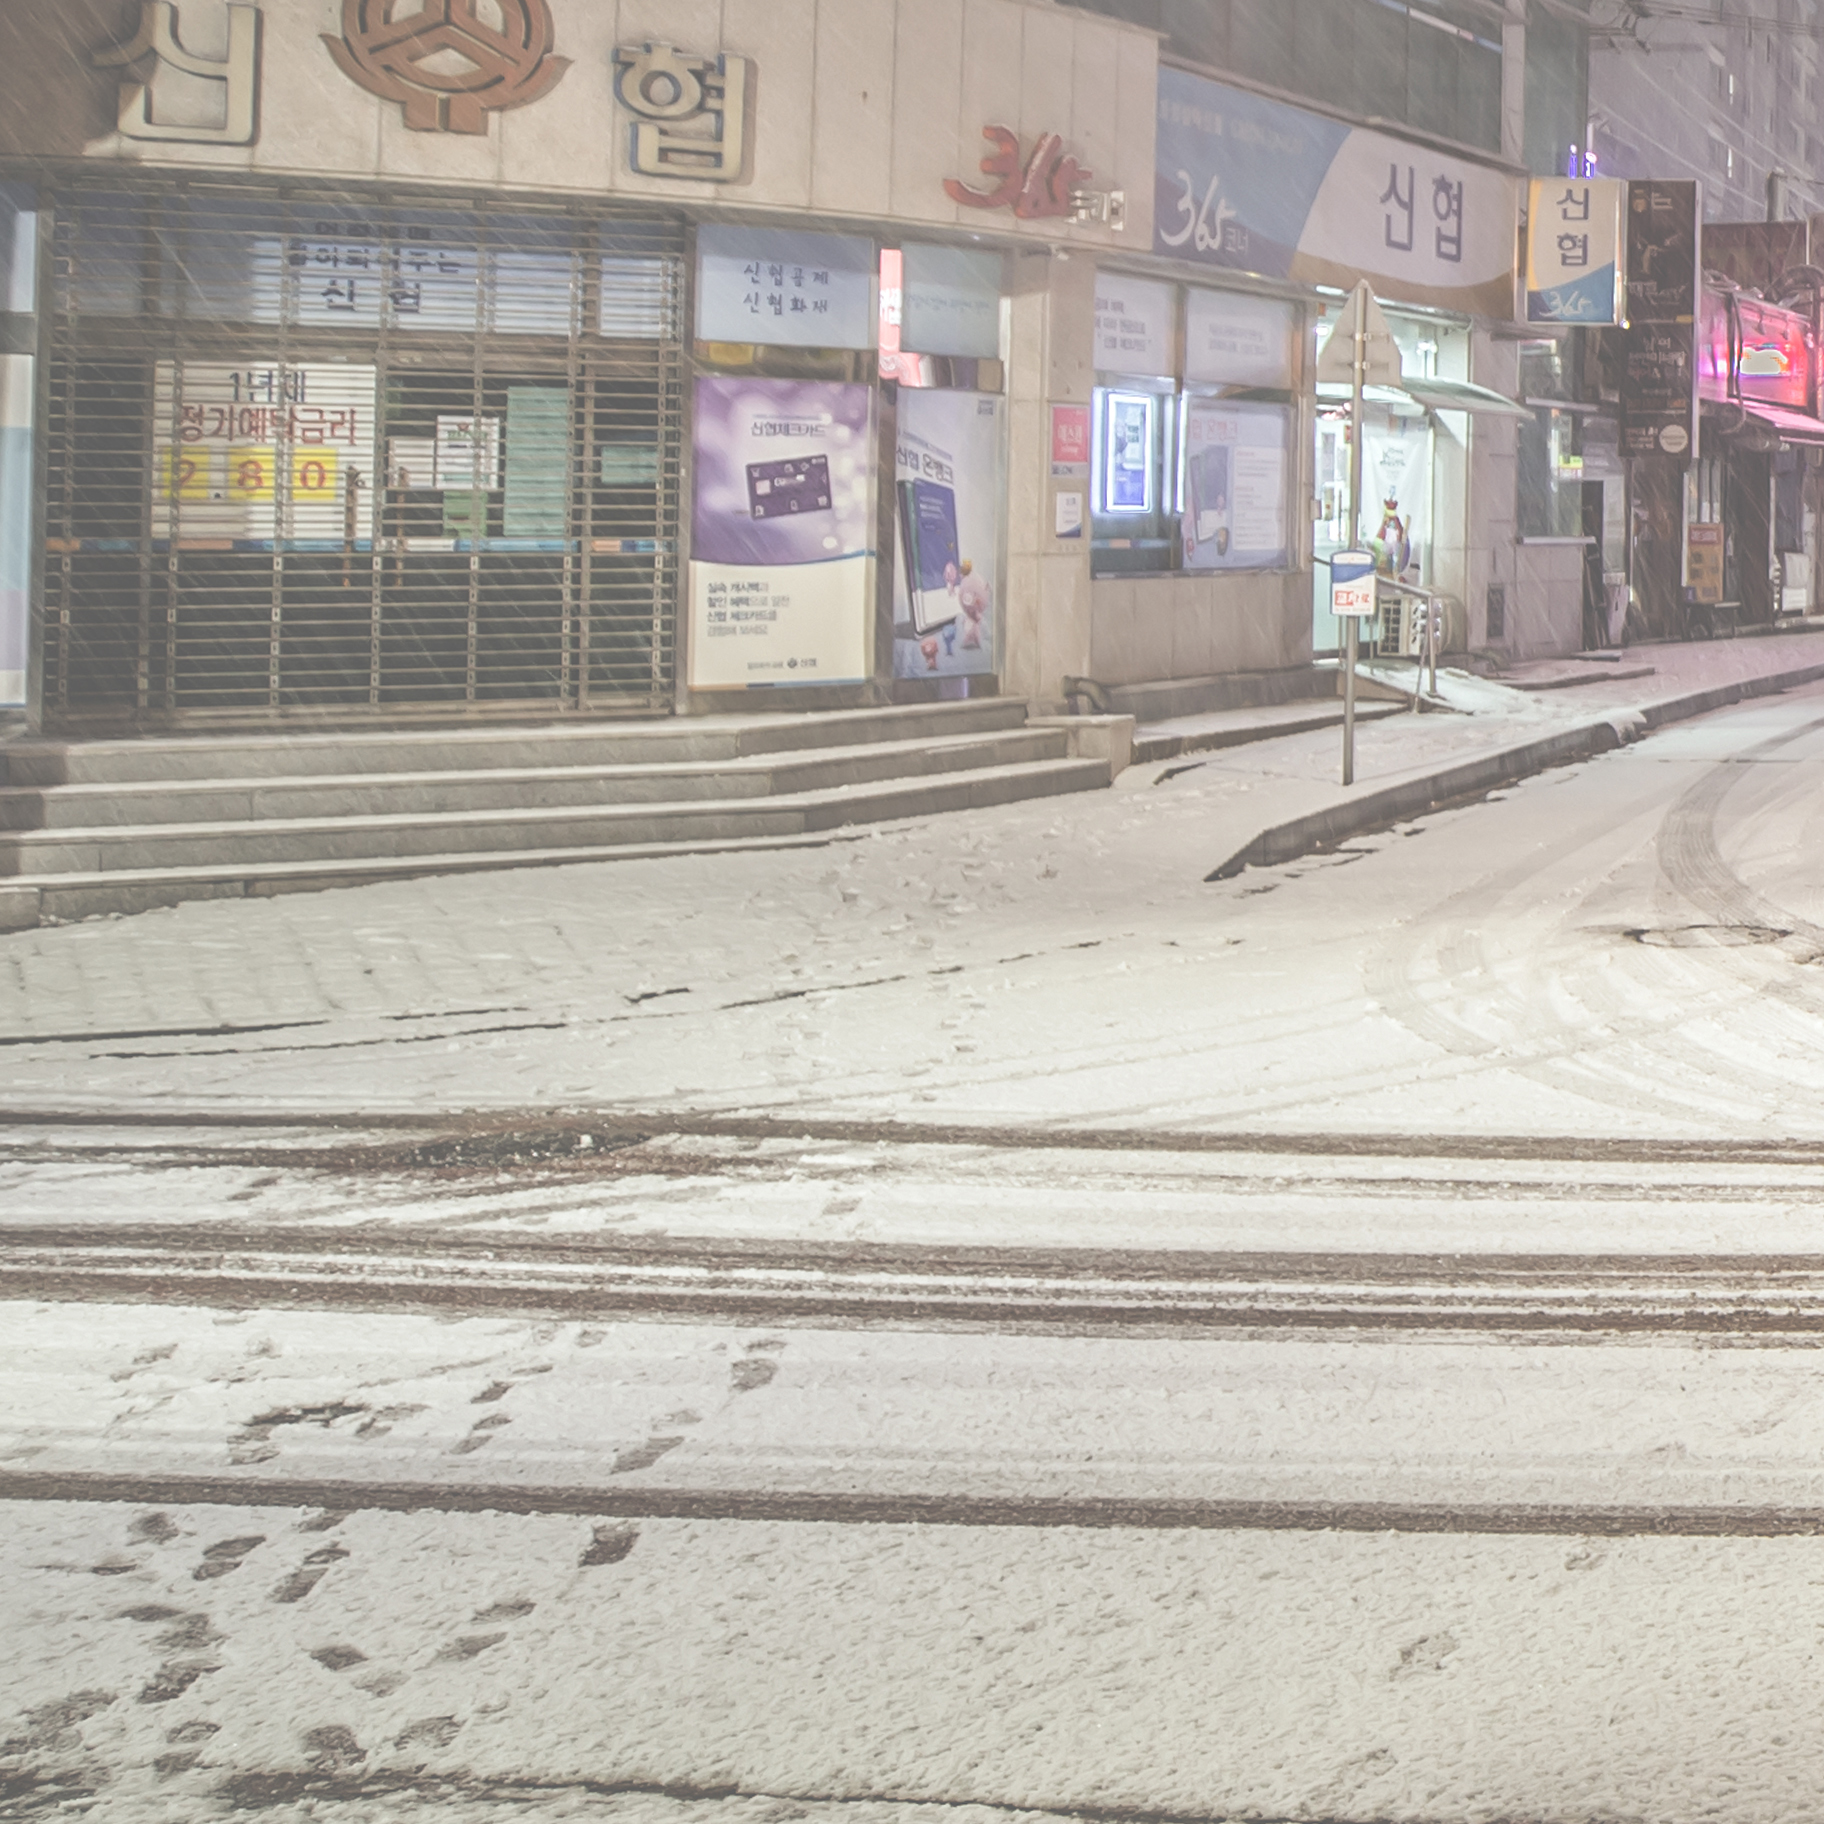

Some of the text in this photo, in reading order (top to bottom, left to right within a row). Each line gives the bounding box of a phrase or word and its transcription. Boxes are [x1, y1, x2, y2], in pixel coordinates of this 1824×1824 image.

[942, 123, 1093, 220] 365
[1159, 168, 1238, 253] 365
[1379, 162, 1465, 263] 신협
[1556, 187, 1590, 267] 신협
[1539, 290, 1593, 318] 365
[750, 421, 828, 438] 신협체크카드
[895, 445, 955, 487] 신협 온뱅크
